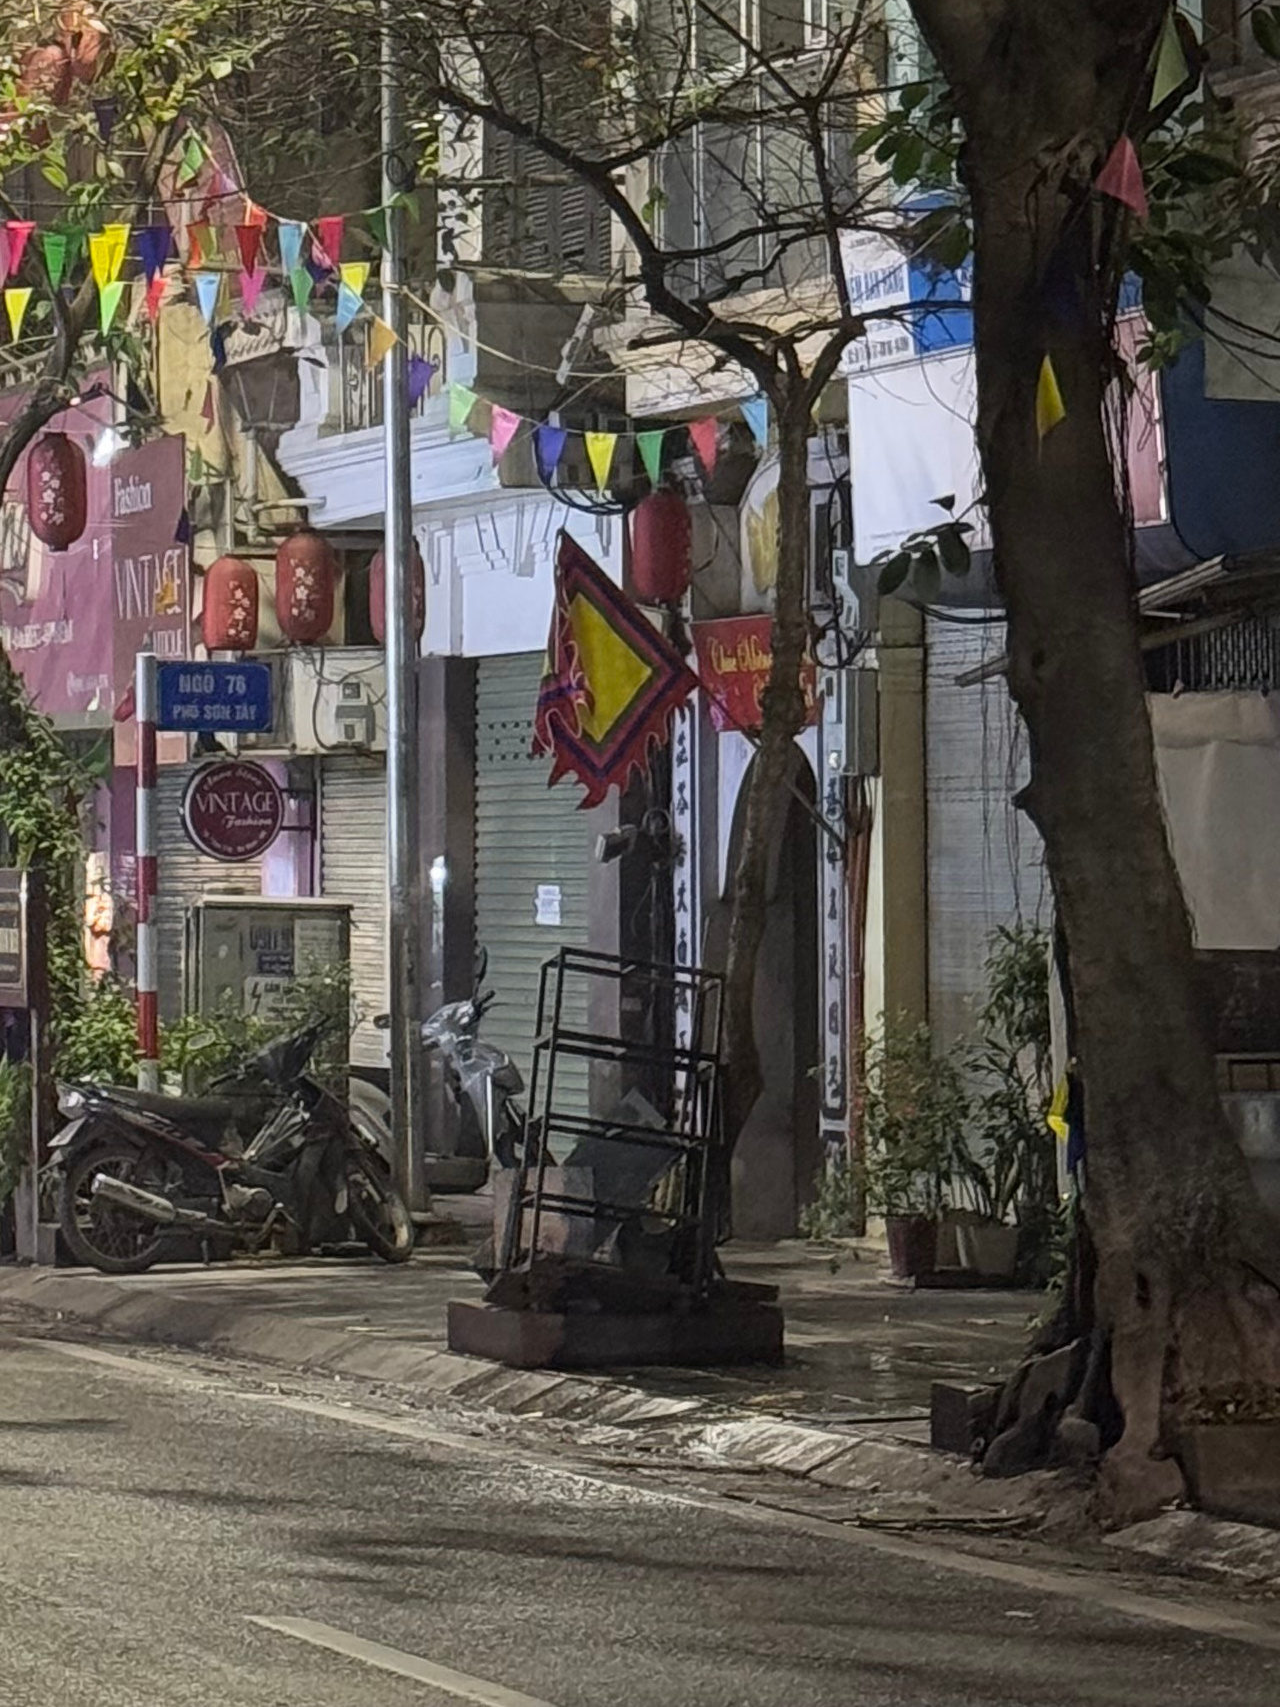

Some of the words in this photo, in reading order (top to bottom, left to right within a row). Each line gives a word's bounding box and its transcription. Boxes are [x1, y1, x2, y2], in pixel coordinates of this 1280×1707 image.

[114, 476, 152, 515] Fashion
[114, 548, 183, 621] VINTAGE
[178, 668, 215, 694] NGÕ
[224, 675, 248, 695] 76
[172, 697, 200, 720] PHỐ
[195, 791, 275, 815] VINTAGE
[221, 814, 274, 830] Fashion
